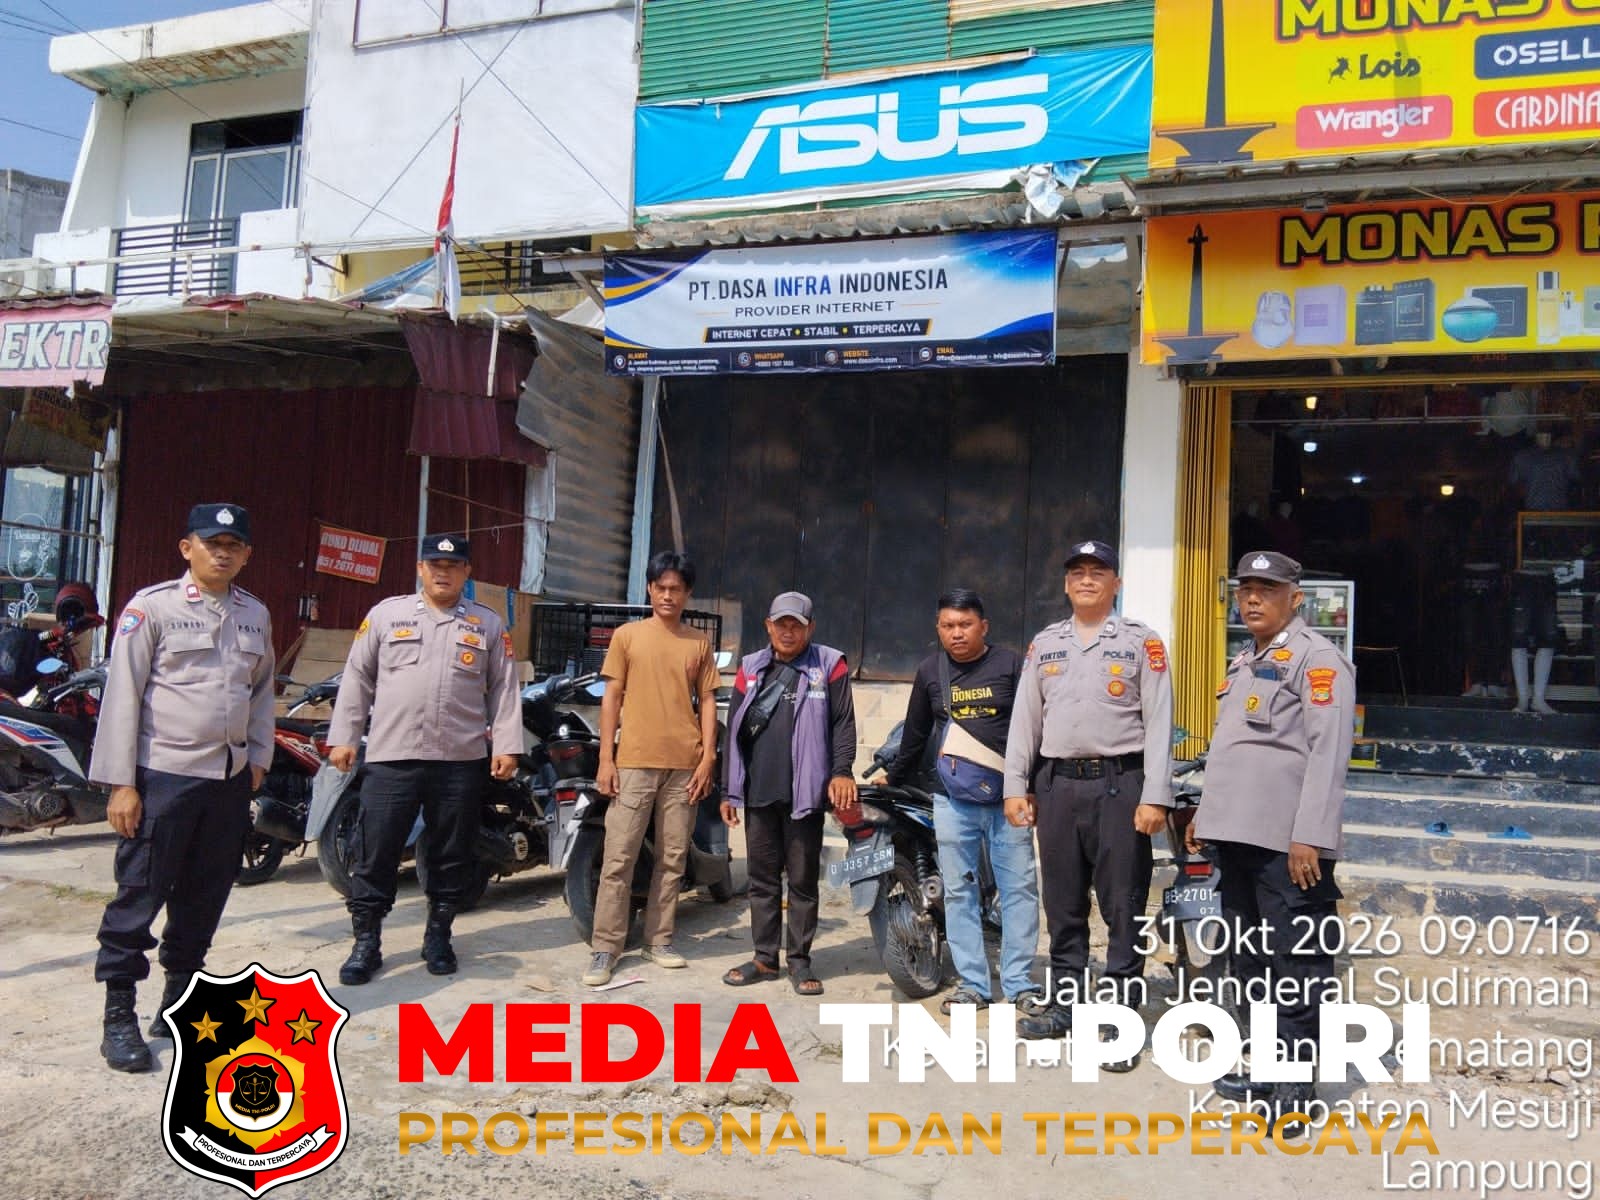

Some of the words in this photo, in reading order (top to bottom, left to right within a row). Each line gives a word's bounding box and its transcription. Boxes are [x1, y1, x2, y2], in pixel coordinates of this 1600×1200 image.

[1359, 51, 1422, 81] Lois
[724, 73, 1048, 180] ASUS
[1315, 104, 1435, 138] Wrangler
[1281, 205, 1557, 265] MONAS
[774, 275, 832, 297] INFRA
[840, 268, 948, 294] INDONESIA
[735, 304, 811, 318] PROVIDER
[816, 300, 895, 314] INTERNET
[0, 319, 112, 370] EKTR
[712, 329, 758, 340] INTERNET
[760, 327, 793, 338] CEPAT
[803, 325, 840, 337] STABIL
[853, 322, 921, 335] TERPERCAYA
[1103, 650, 1135, 661] POLRI
[952, 687, 993, 702] DONESIA
